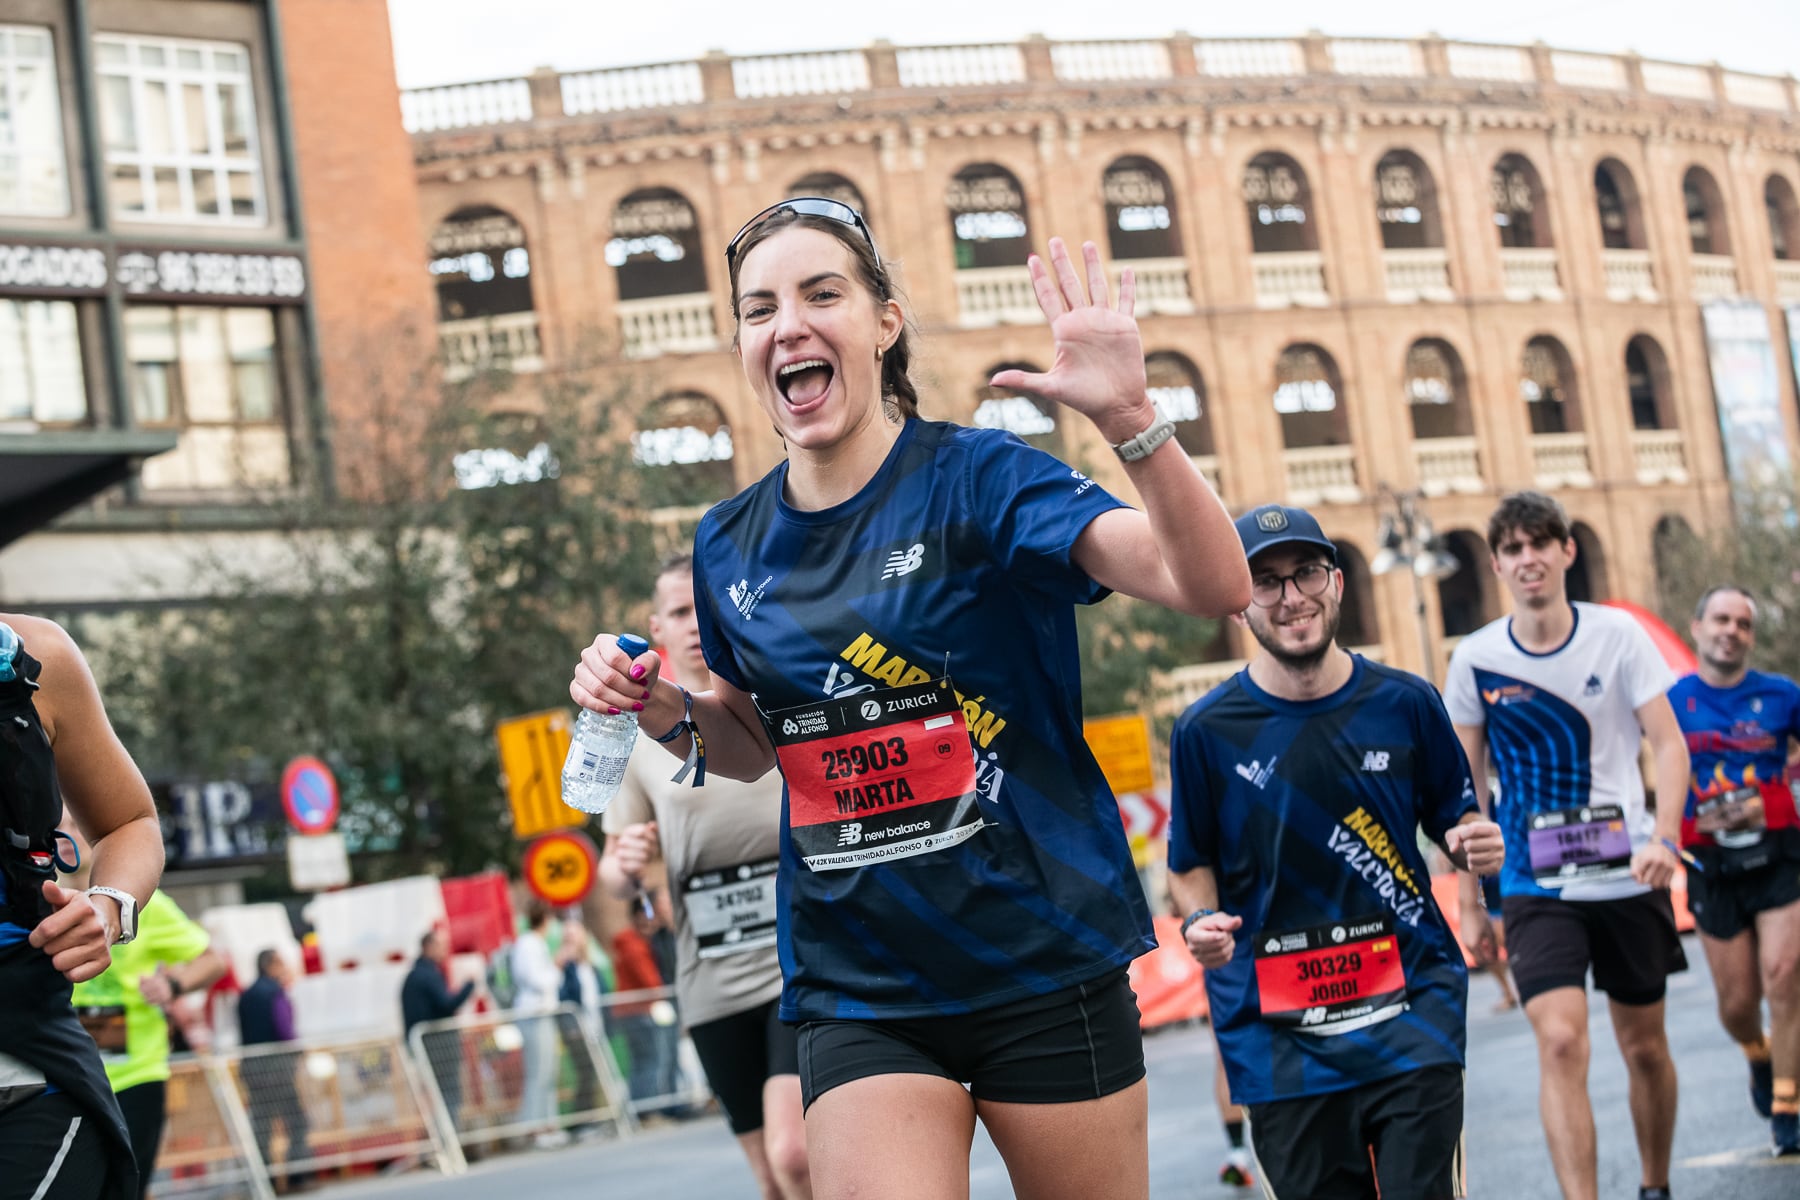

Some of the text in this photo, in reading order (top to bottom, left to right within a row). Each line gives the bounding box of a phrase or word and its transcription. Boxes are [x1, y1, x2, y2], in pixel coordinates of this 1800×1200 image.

[840, 632, 1006, 749] MARÓN
[886, 693, 938, 712] ZURICH
[799, 716, 827, 728] TRINIDAD
[801, 723, 829, 735] ALFONSO
[821, 737, 909, 780] 25903
[834, 777, 915, 815] MARTA
[864, 831, 886, 842] new
[888, 820, 931, 838] balance
[827, 855, 854, 865] VALENCIA
[854, 851, 886, 863] TRINIDAD
[886, 842, 922, 857] ALFONSO
[1349, 921, 1384, 938] ZURICH
[1296, 952, 1362, 981] 30329
[1308, 979, 1358, 1003] JORDI
